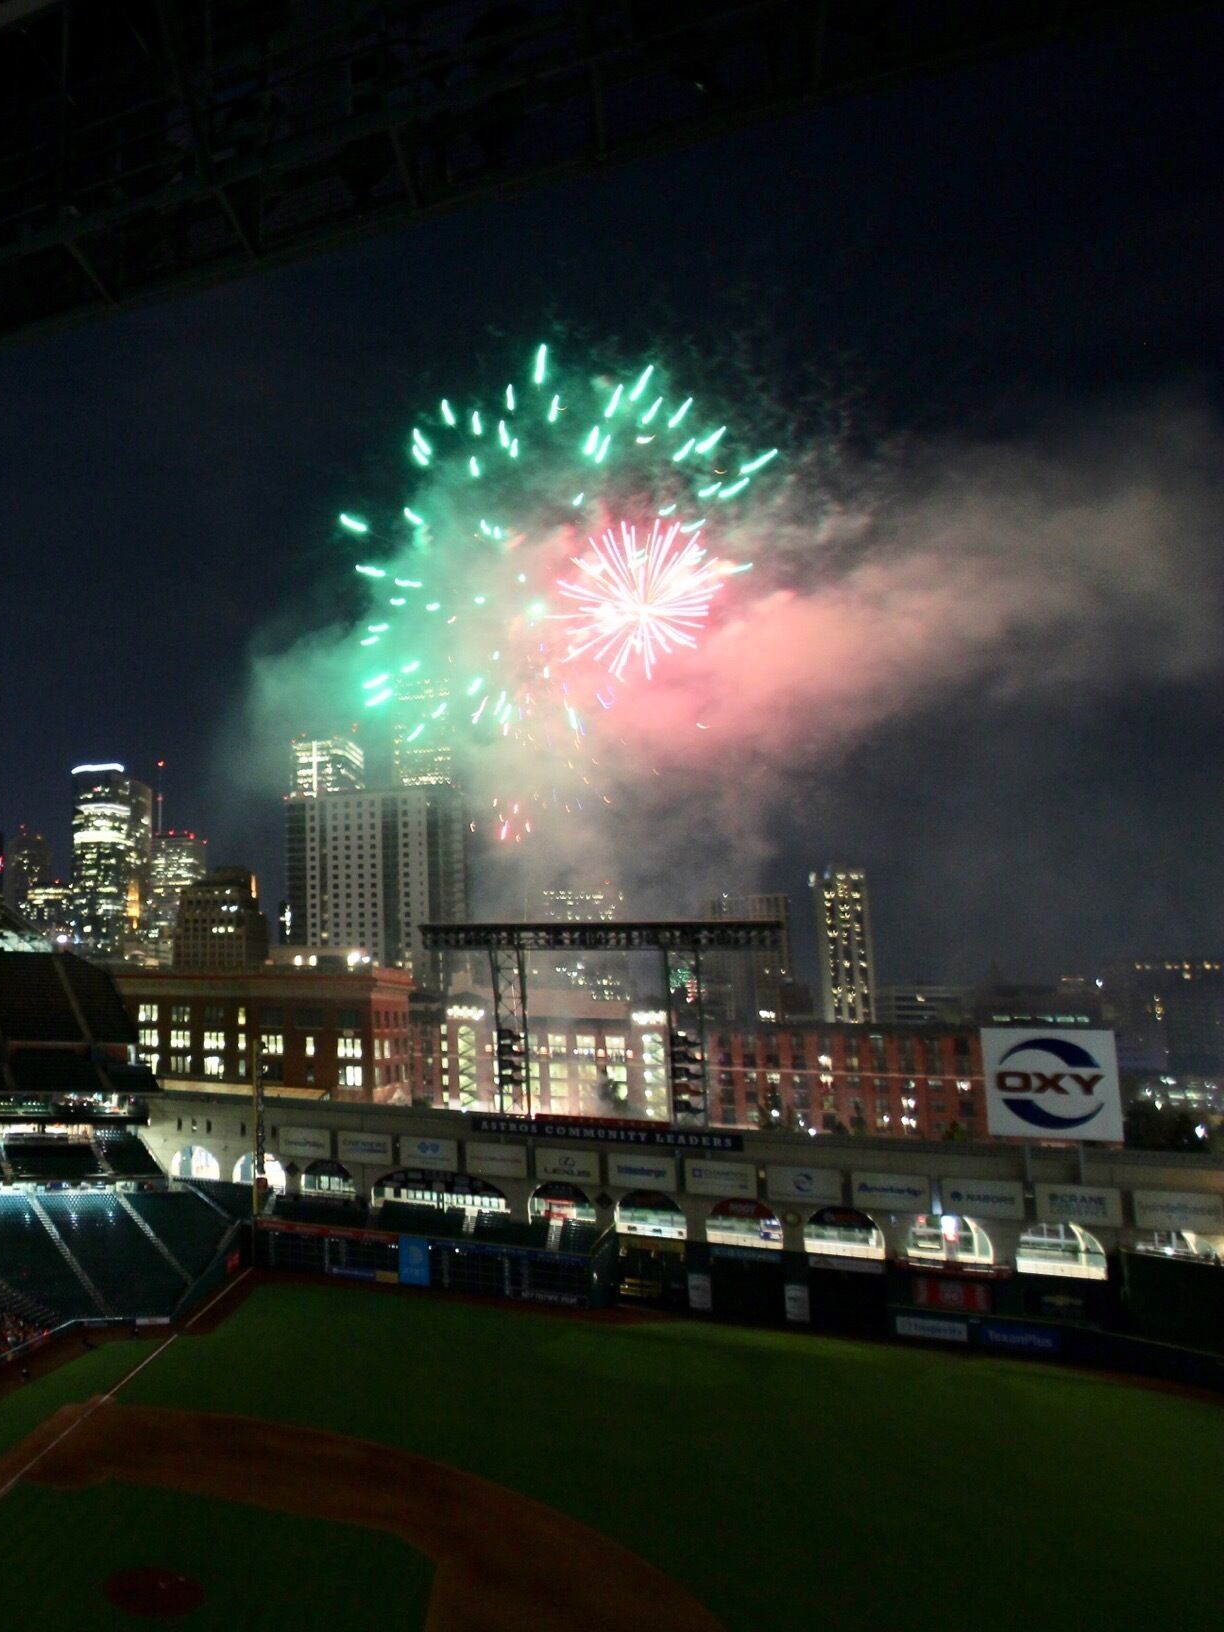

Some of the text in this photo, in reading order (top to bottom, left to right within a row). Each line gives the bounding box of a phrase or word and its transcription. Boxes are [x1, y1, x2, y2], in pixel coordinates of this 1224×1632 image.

[996, 1071, 1105, 1096] OXY
[480, 1120, 538, 1134] ASTROS
[545, 1126, 648, 1142] COMMUNITY
[655, 1133, 733, 1148] LEADERS
[543, 1166, 591, 1177] LEXUS
